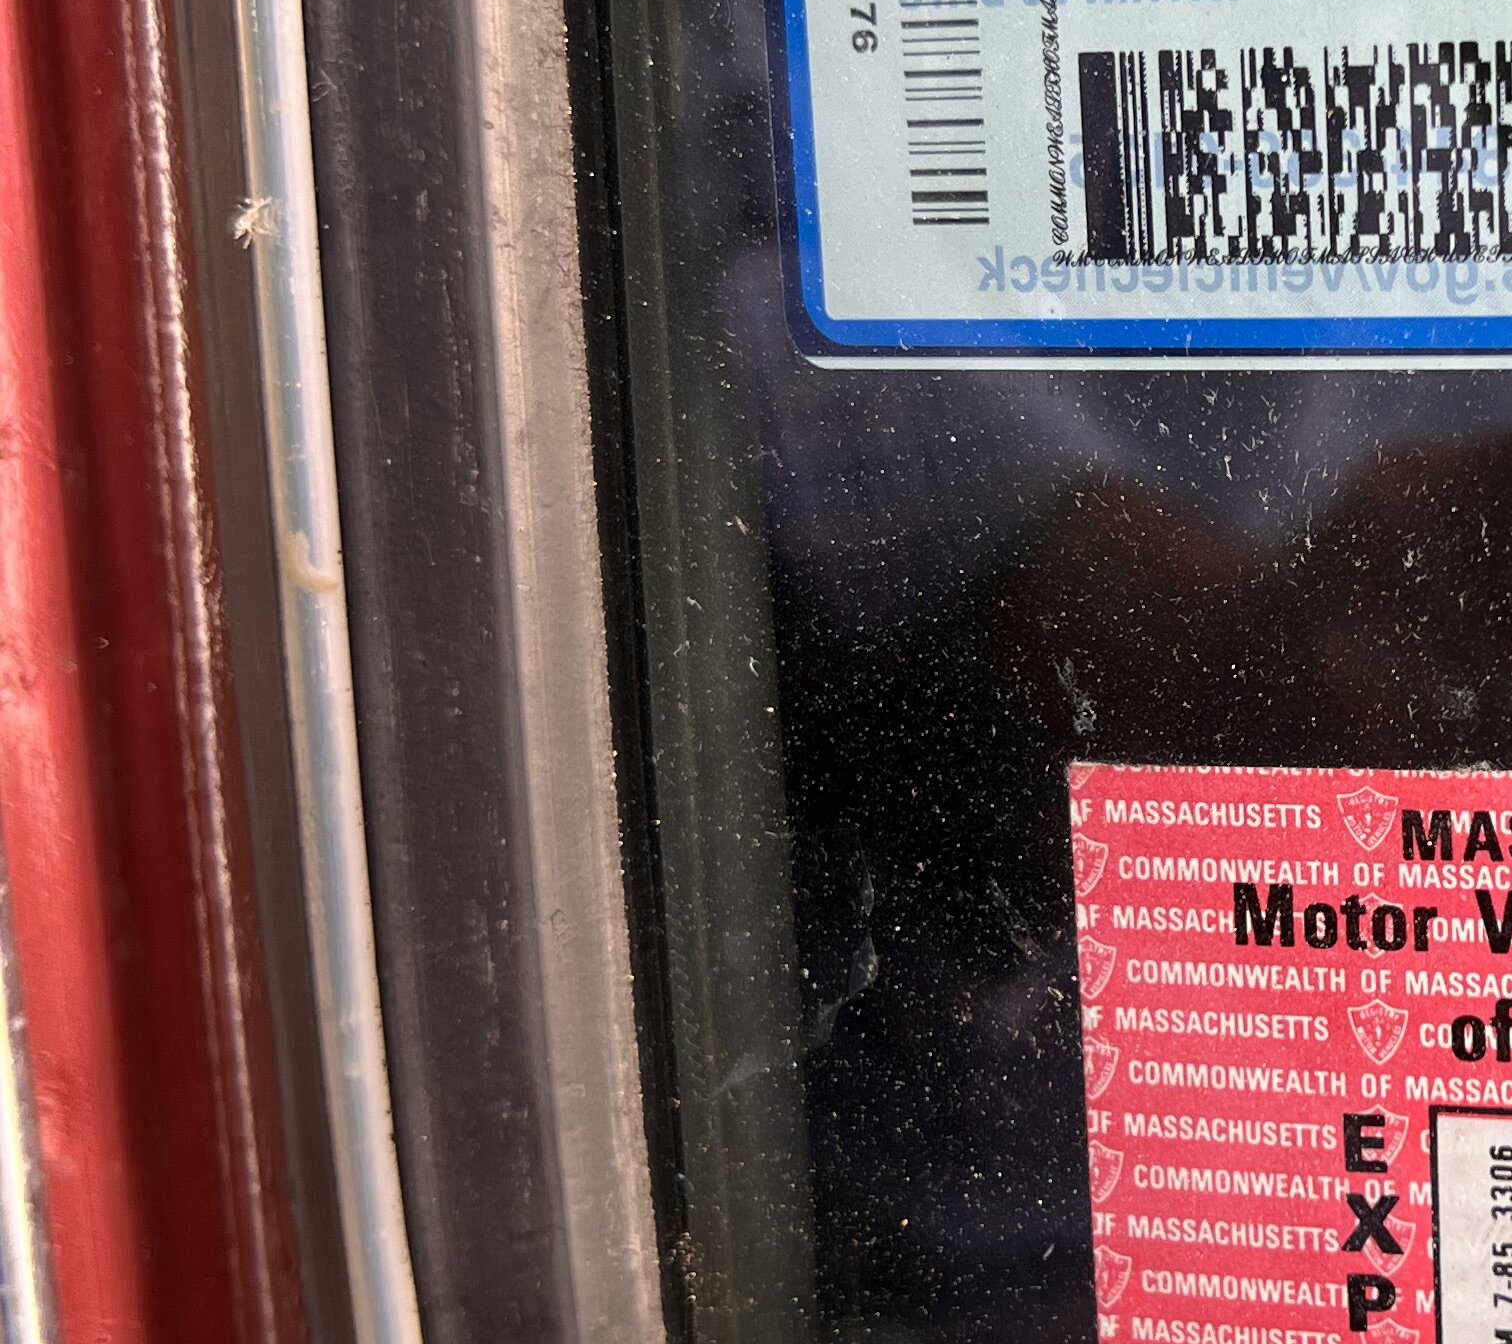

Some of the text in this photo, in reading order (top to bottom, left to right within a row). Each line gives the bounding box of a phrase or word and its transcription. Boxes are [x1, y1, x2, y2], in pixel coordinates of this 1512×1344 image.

[1105, 799, 1321, 829] MASSACHUSETTS
[1118, 856, 1338, 885] COMMONWEALTH
[1354, 862, 1384, 886] OF
[1232, 882, 1438, 953] Motor
[1126, 959, 1346, 991] COMMONWEALTH
[1360, 969, 1391, 994] OF
[1116, 1007, 1329, 1041] MASSACHUSETTS
[1128, 1061, 1346, 1096] COMMONWEALTH
[1361, 1073, 1391, 1098] OF
[1124, 1113, 1336, 1150] MASSACHUSETTS
[1133, 1165, 1350, 1201] COMMONWEALTH
[1128, 1215, 1338, 1252] MASSACHUSETTS
